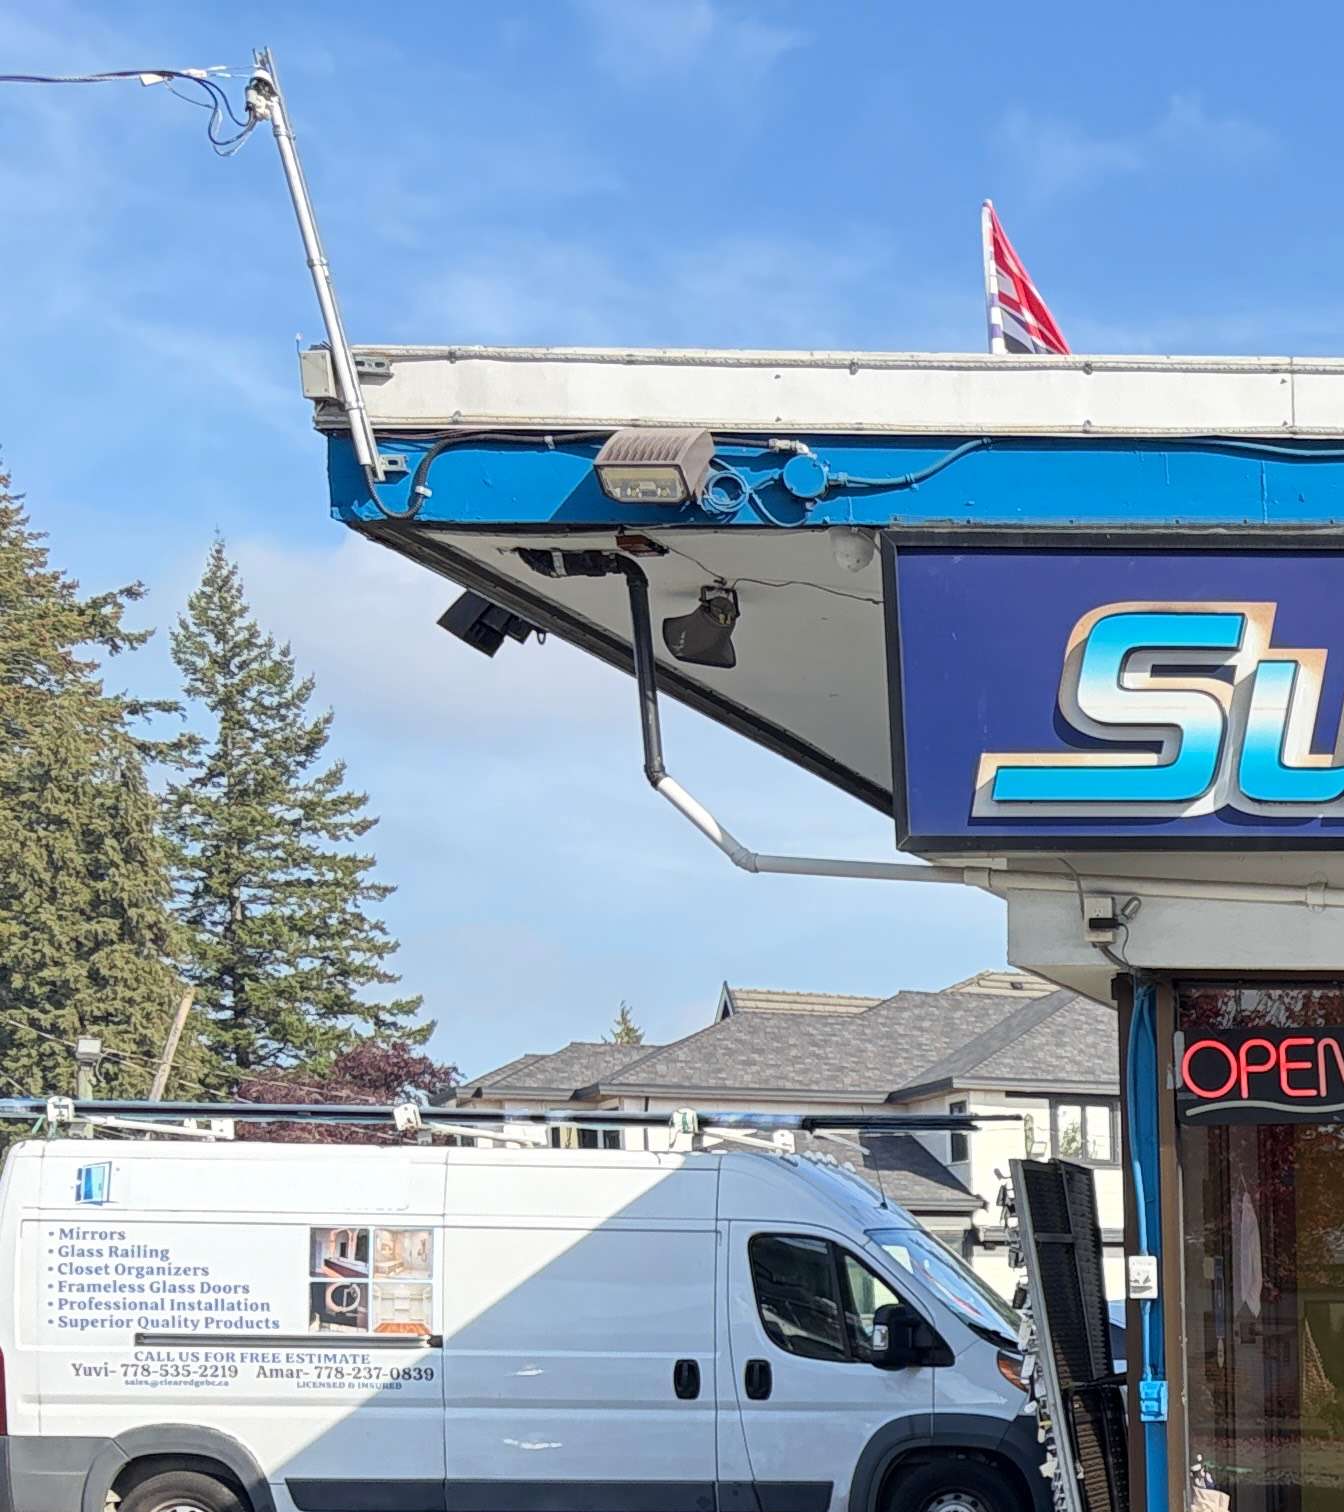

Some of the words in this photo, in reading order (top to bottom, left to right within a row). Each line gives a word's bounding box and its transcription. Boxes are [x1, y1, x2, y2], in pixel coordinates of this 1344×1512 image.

[58, 1227, 126, 1241] Mirrors
[58, 1245, 104, 1258] Glass
[108, 1245, 170, 1262] Railing
[58, 1263, 110, 1276] Closet
[114, 1263, 210, 1279] Organizers
[58, 1280, 145, 1294] Frameless
[149, 1281, 196, 1294] Glass
[200, 1281, 251, 1295] Doors
[58, 1297, 165, 1312] Professional
[169, 1298, 271, 1312] Installation
[58, 1315, 133, 1331] Superior
[137, 1315, 200, 1331] Quality
[204, 1316, 281, 1330] Products
[134, 1351, 175, 1362] CALL
[179, 1351, 200, 1362] US
[204, 1352, 236, 1363] FOR
[240, 1352, 281, 1363] FREE
[285, 1353, 371, 1365] ESTIMATE
[121, 1363, 239, 1378] 778-535-2219
[314, 1366, 435, 1381] 778-237-0839
